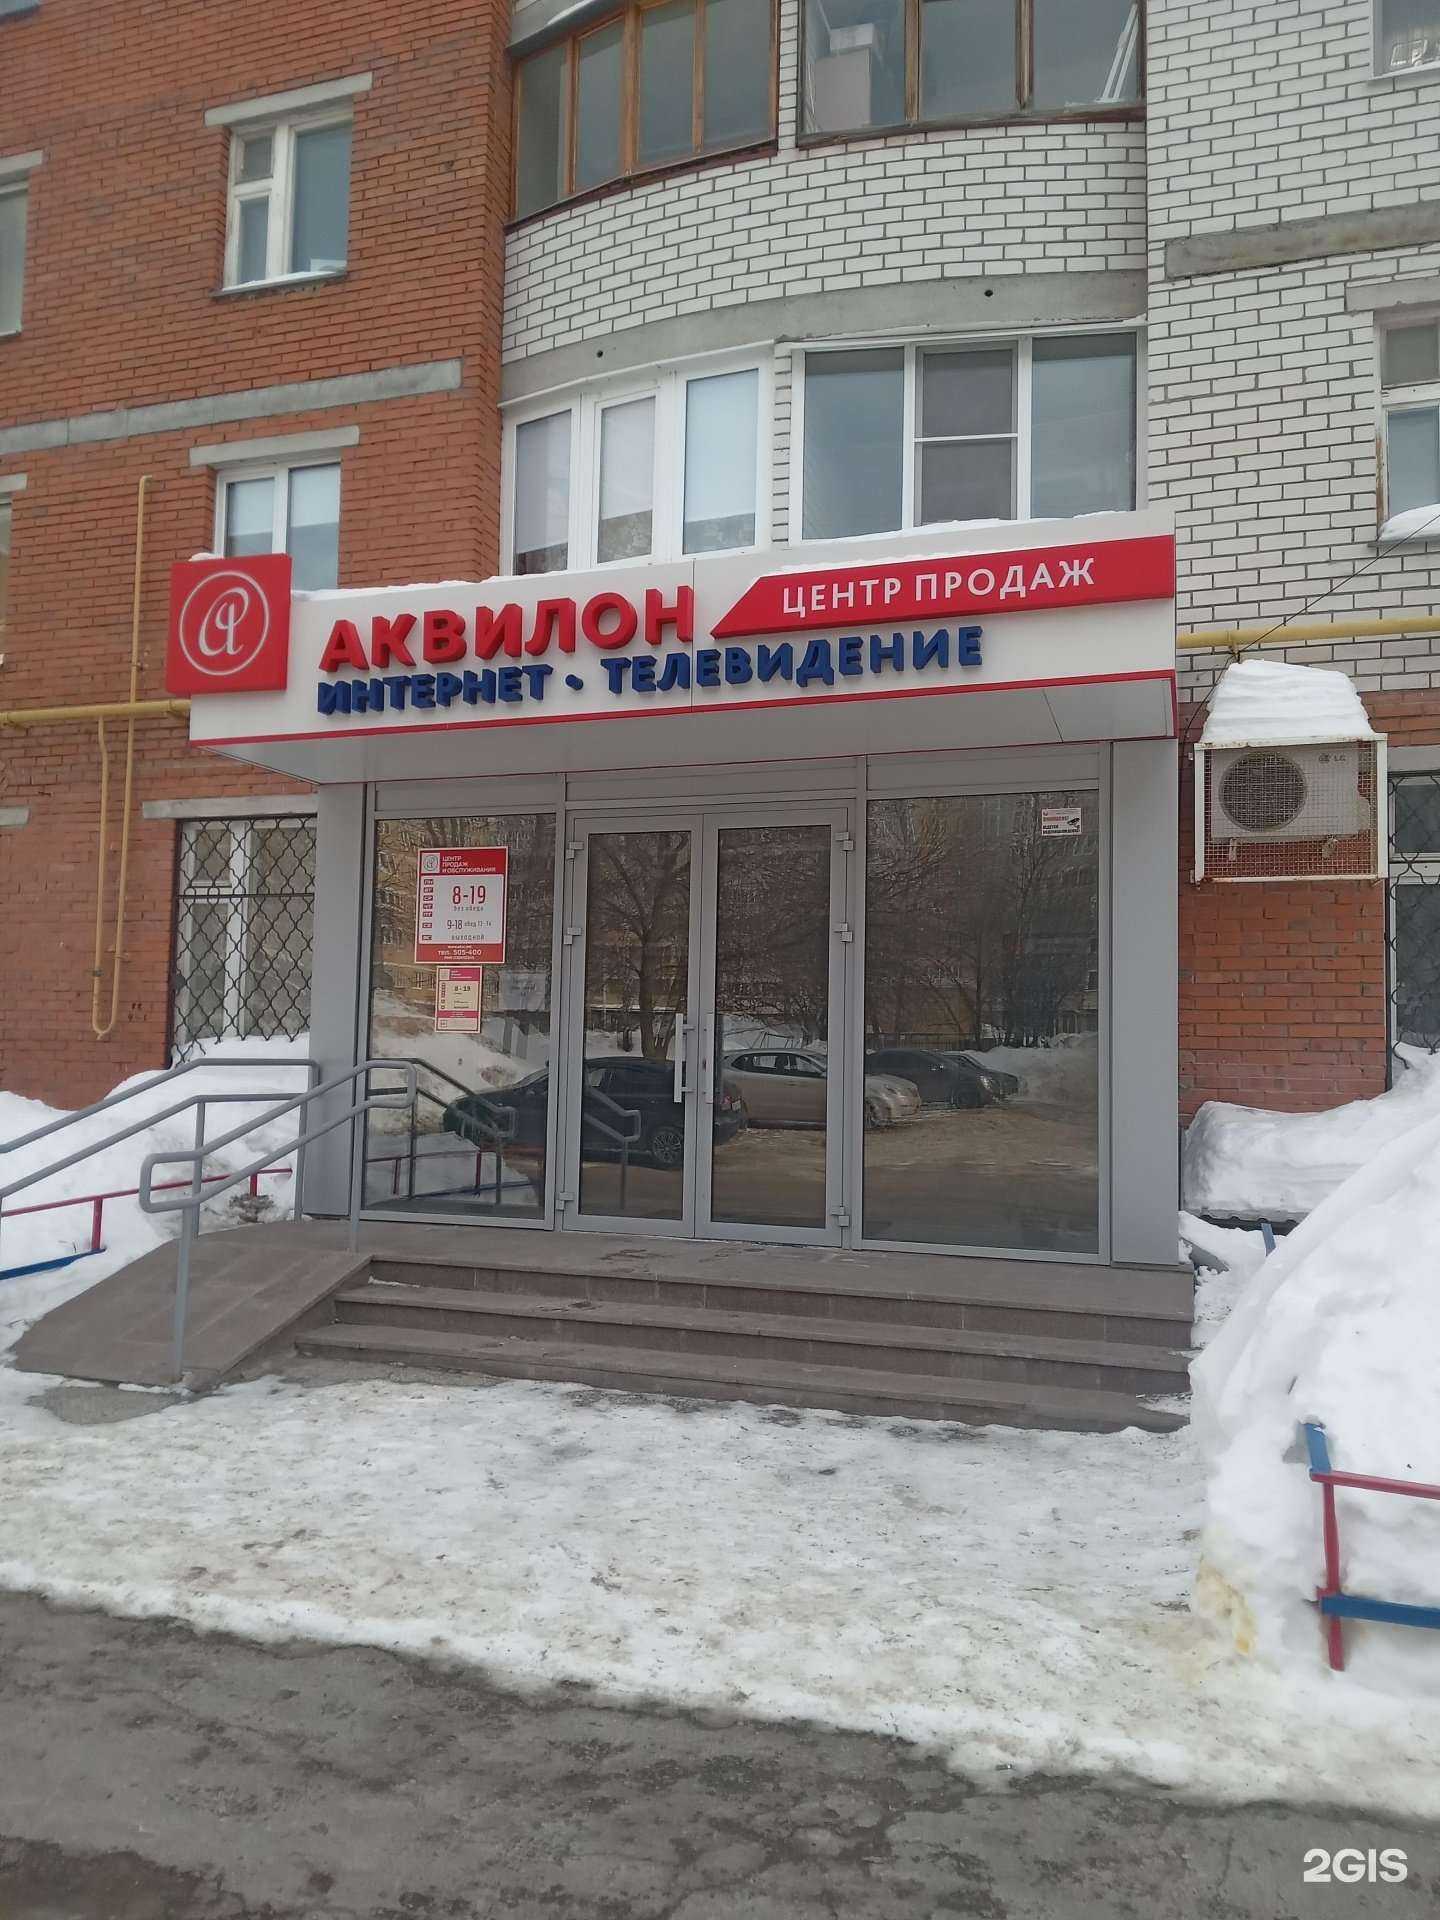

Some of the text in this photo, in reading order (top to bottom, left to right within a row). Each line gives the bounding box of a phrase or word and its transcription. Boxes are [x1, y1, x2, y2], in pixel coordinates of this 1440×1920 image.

[783, 557, 1095, 618] ЦЕНТР ПРОДАЖ
[319, 584, 695, 672] АКВИЛОН
[317, 626, 983, 716] ИНТЕРНЕТ ТЕЛЕВИДЕНИЕ
[447, 919, 463, 930] 9-18
[453, 885, 486, 905] 8-19
